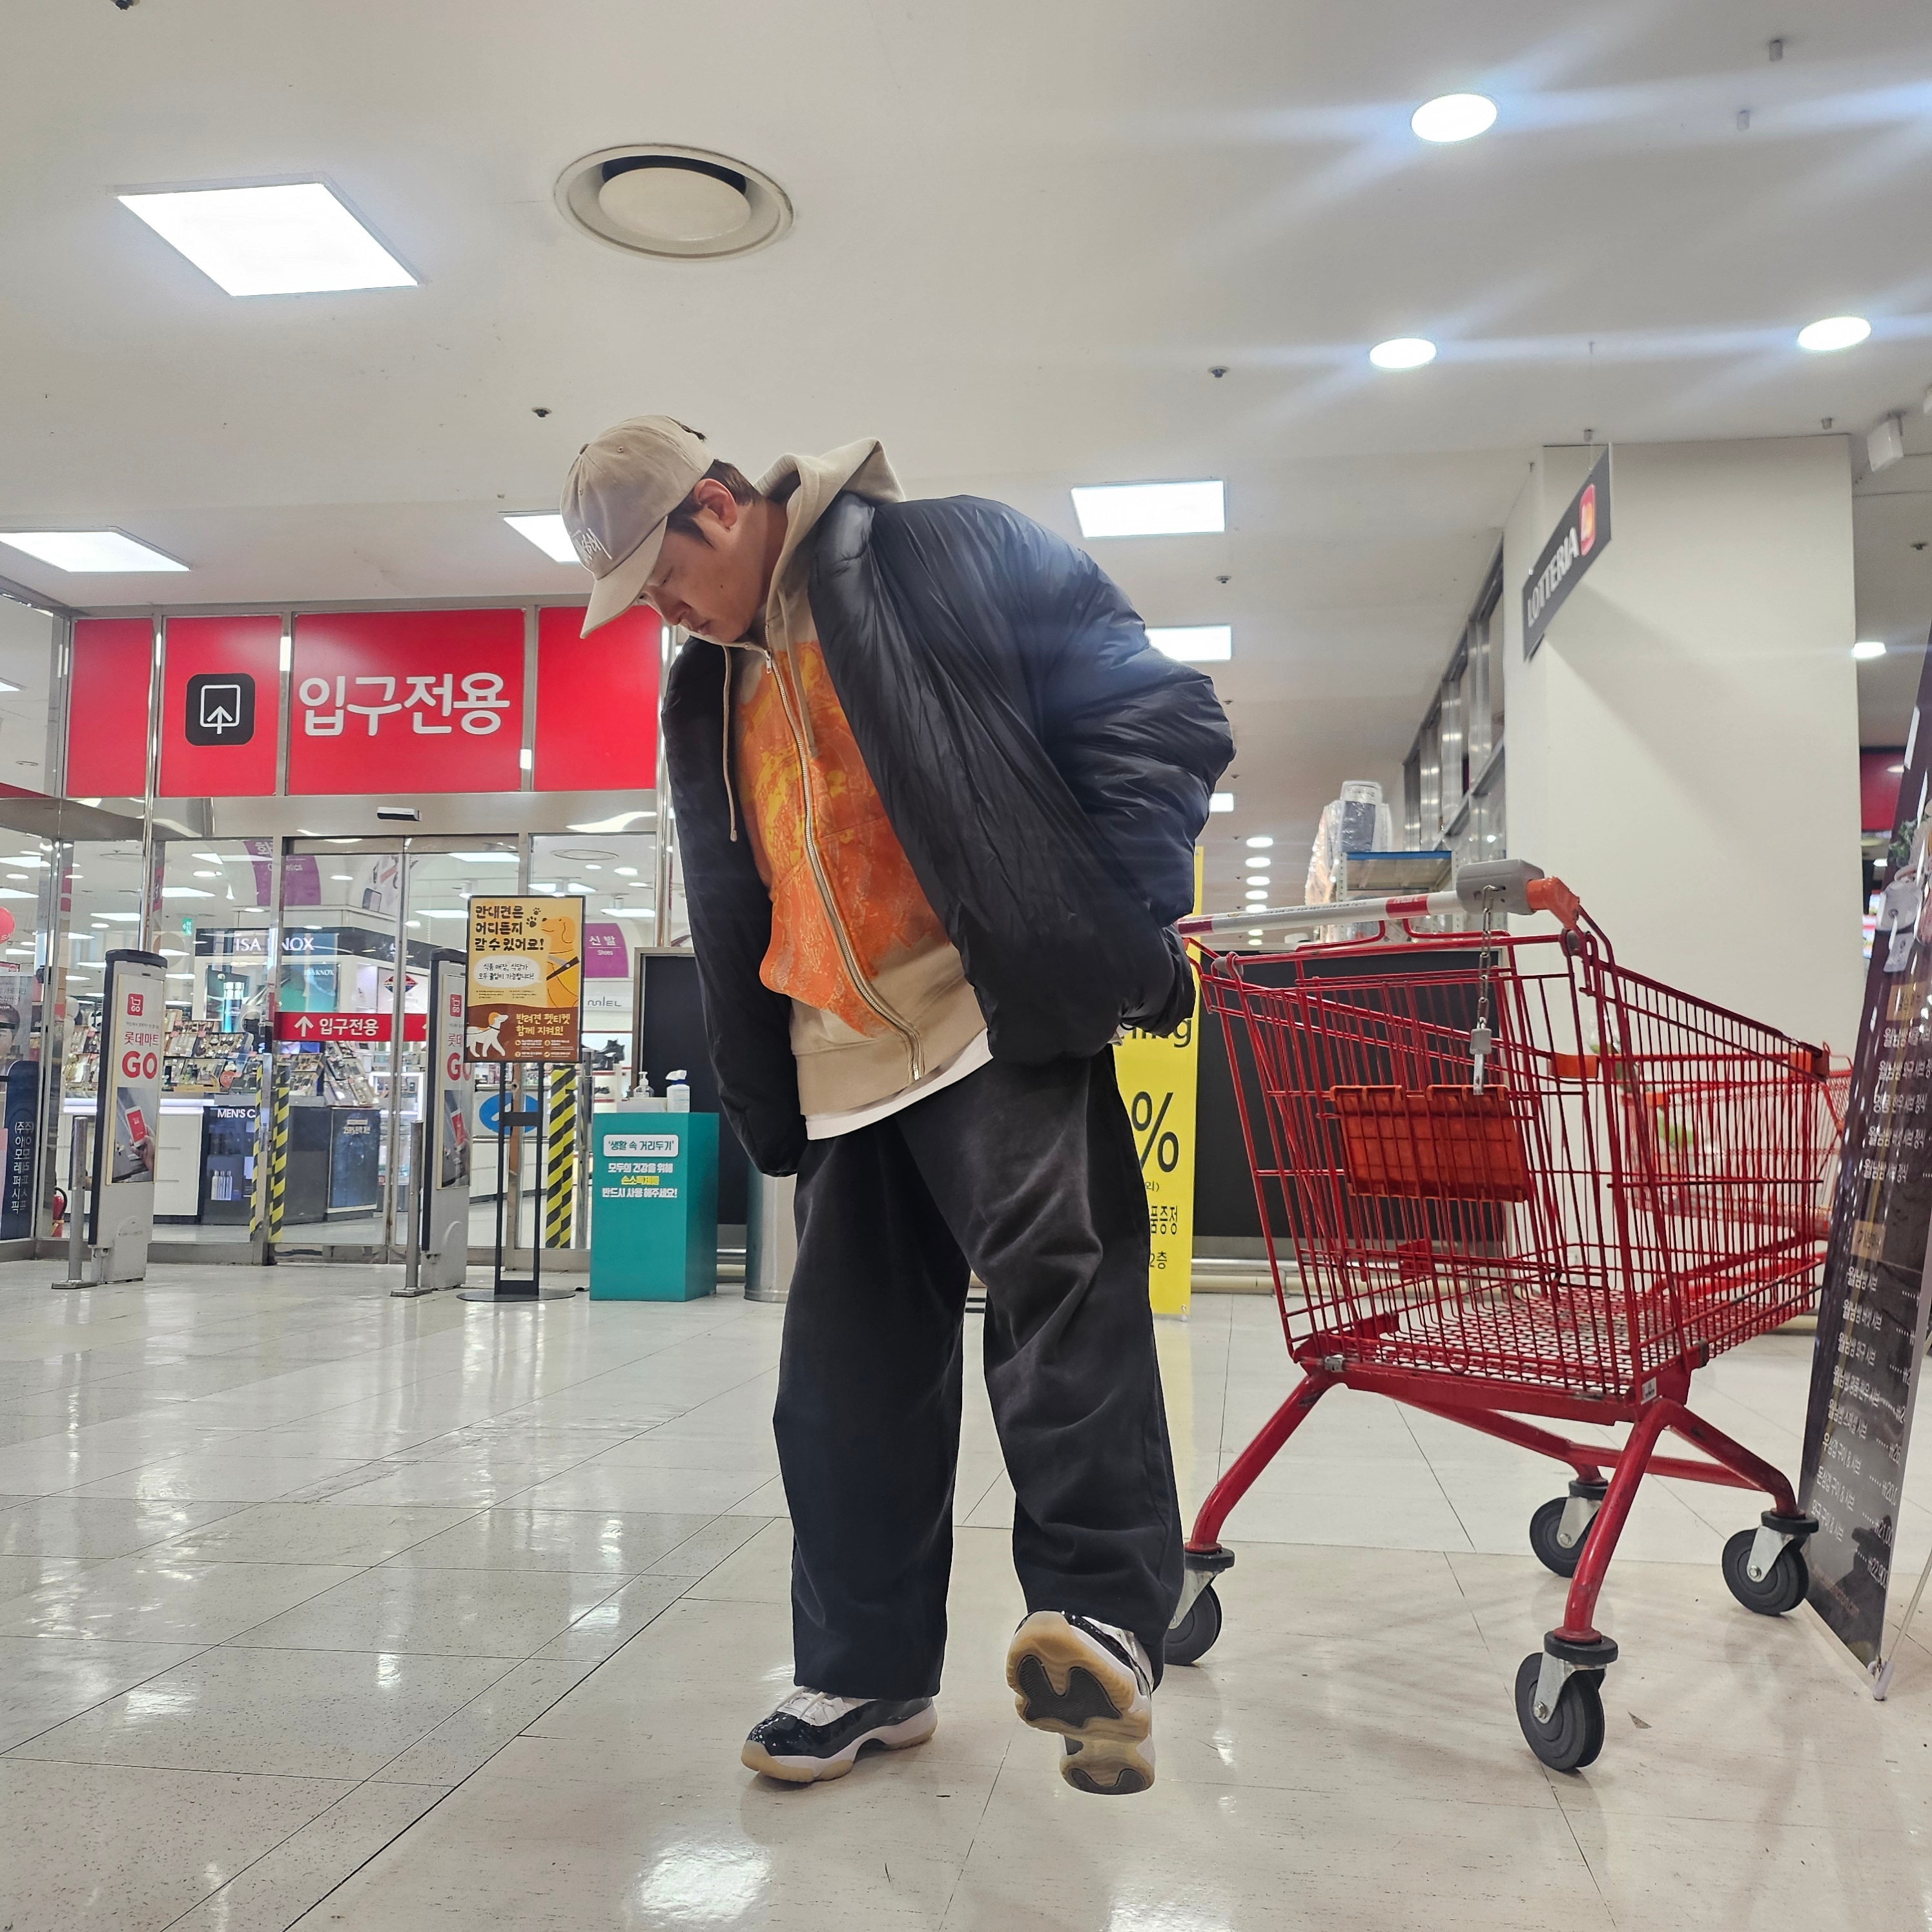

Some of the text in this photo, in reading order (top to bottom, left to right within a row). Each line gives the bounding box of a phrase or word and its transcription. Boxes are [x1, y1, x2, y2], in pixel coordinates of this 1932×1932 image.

[1528, 527, 1579, 628] LOTTERIA
[299, 672, 511, 736] 입구전용
[475, 905, 524, 919] 안내견은
[475, 921, 523, 935] 어디든지
[279, 937, 314, 951] NOX
[475, 938, 544, 951] 갈 수 있어요!
[319, 1018, 379, 1036] 입구전용
[516, 1014, 571, 1025] 반려견 펫티켓
[125, 1031, 159, 1047] 롯데마트
[516, 1026, 535, 1037] 함께
[121, 1051, 158, 1080] GO
[217, 1109, 246, 1118] MEN'S
[1915, 1094, 1927, 1115] 정식
[629, 1141, 637, 1151] 속
[640, 1140, 674, 1151] 거리두기'
[1914, 1129, 1926, 1149] 정식
[608, 1163, 673, 1173] 모두의 건강을 위해
[1897, 1164, 1909, 1184] 정식
[602, 1187, 677, 1198] 반드시 사용 해주세요!
[1847, 1266, 1868, 1291] 월남쌈
[1842, 1299, 1862, 1324] 월남쌈
[1838, 1332, 1856, 1358] 월남쌈
[1828, 1399, 1844, 1425] 월남쌈
[1837, 1443, 1847, 1465] 구이
[1831, 1477, 1840, 1500] 구이
[1821, 1507, 1830, 1530] 구이
